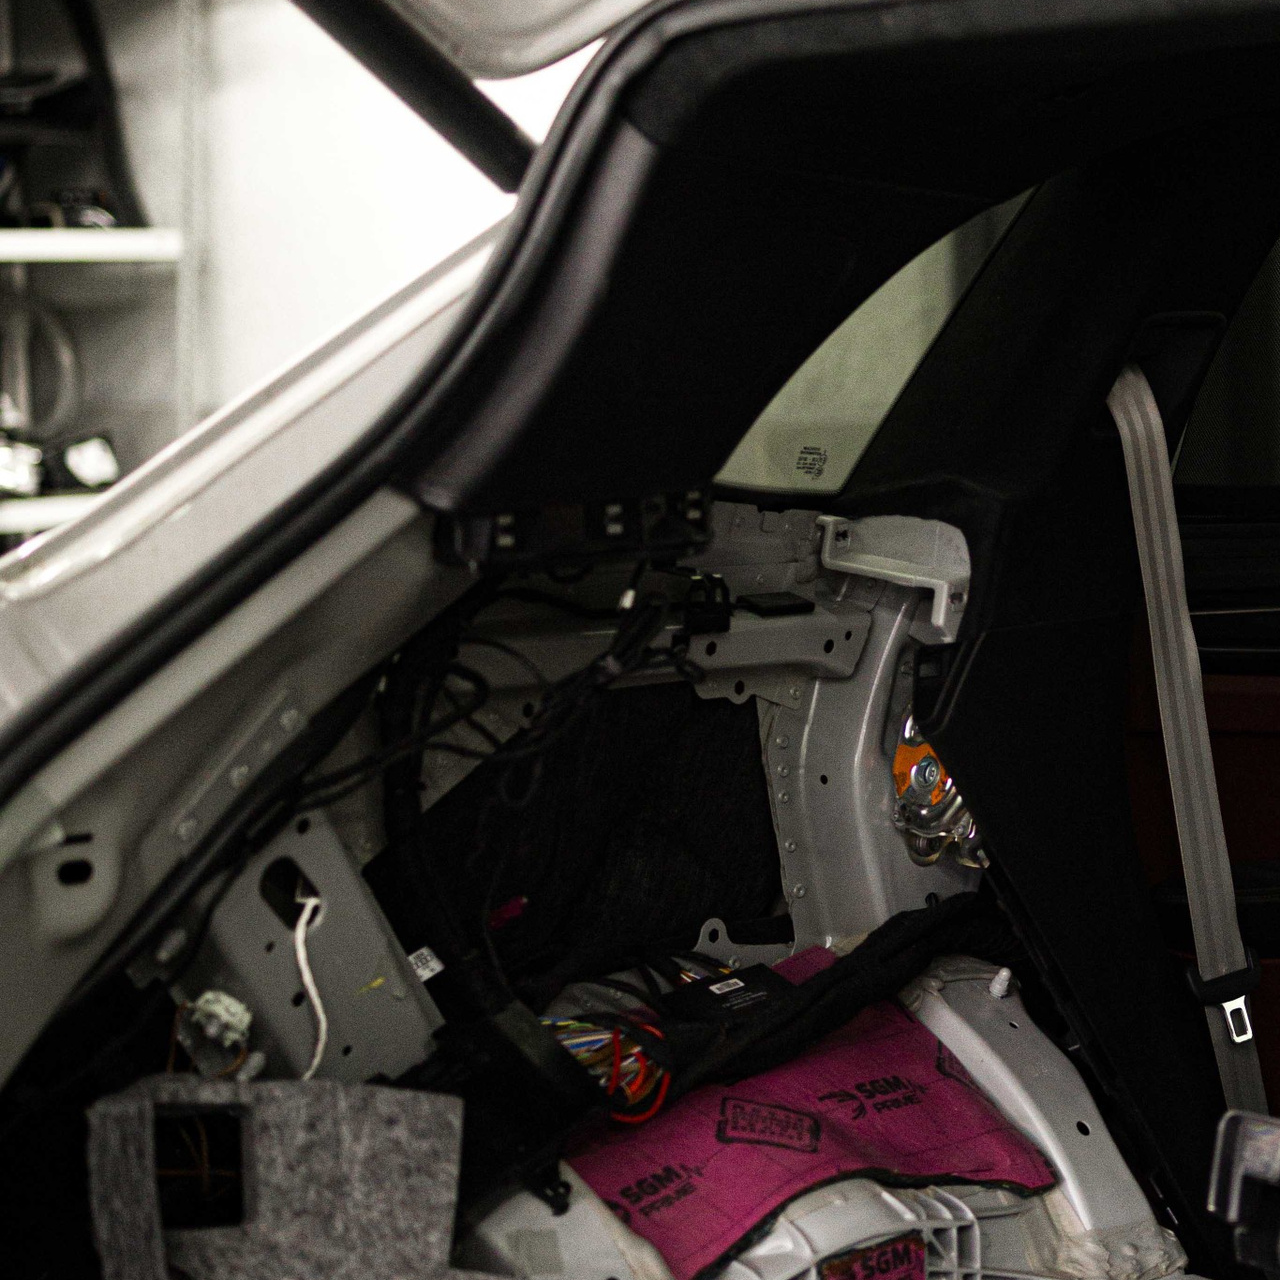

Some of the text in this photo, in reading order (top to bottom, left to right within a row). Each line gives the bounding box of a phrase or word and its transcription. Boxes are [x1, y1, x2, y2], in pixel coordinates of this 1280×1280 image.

[855, 1075, 908, 1099] SGM
[619, 1164, 682, 1206] SGM
[861, 1243, 914, 1280] SGM
